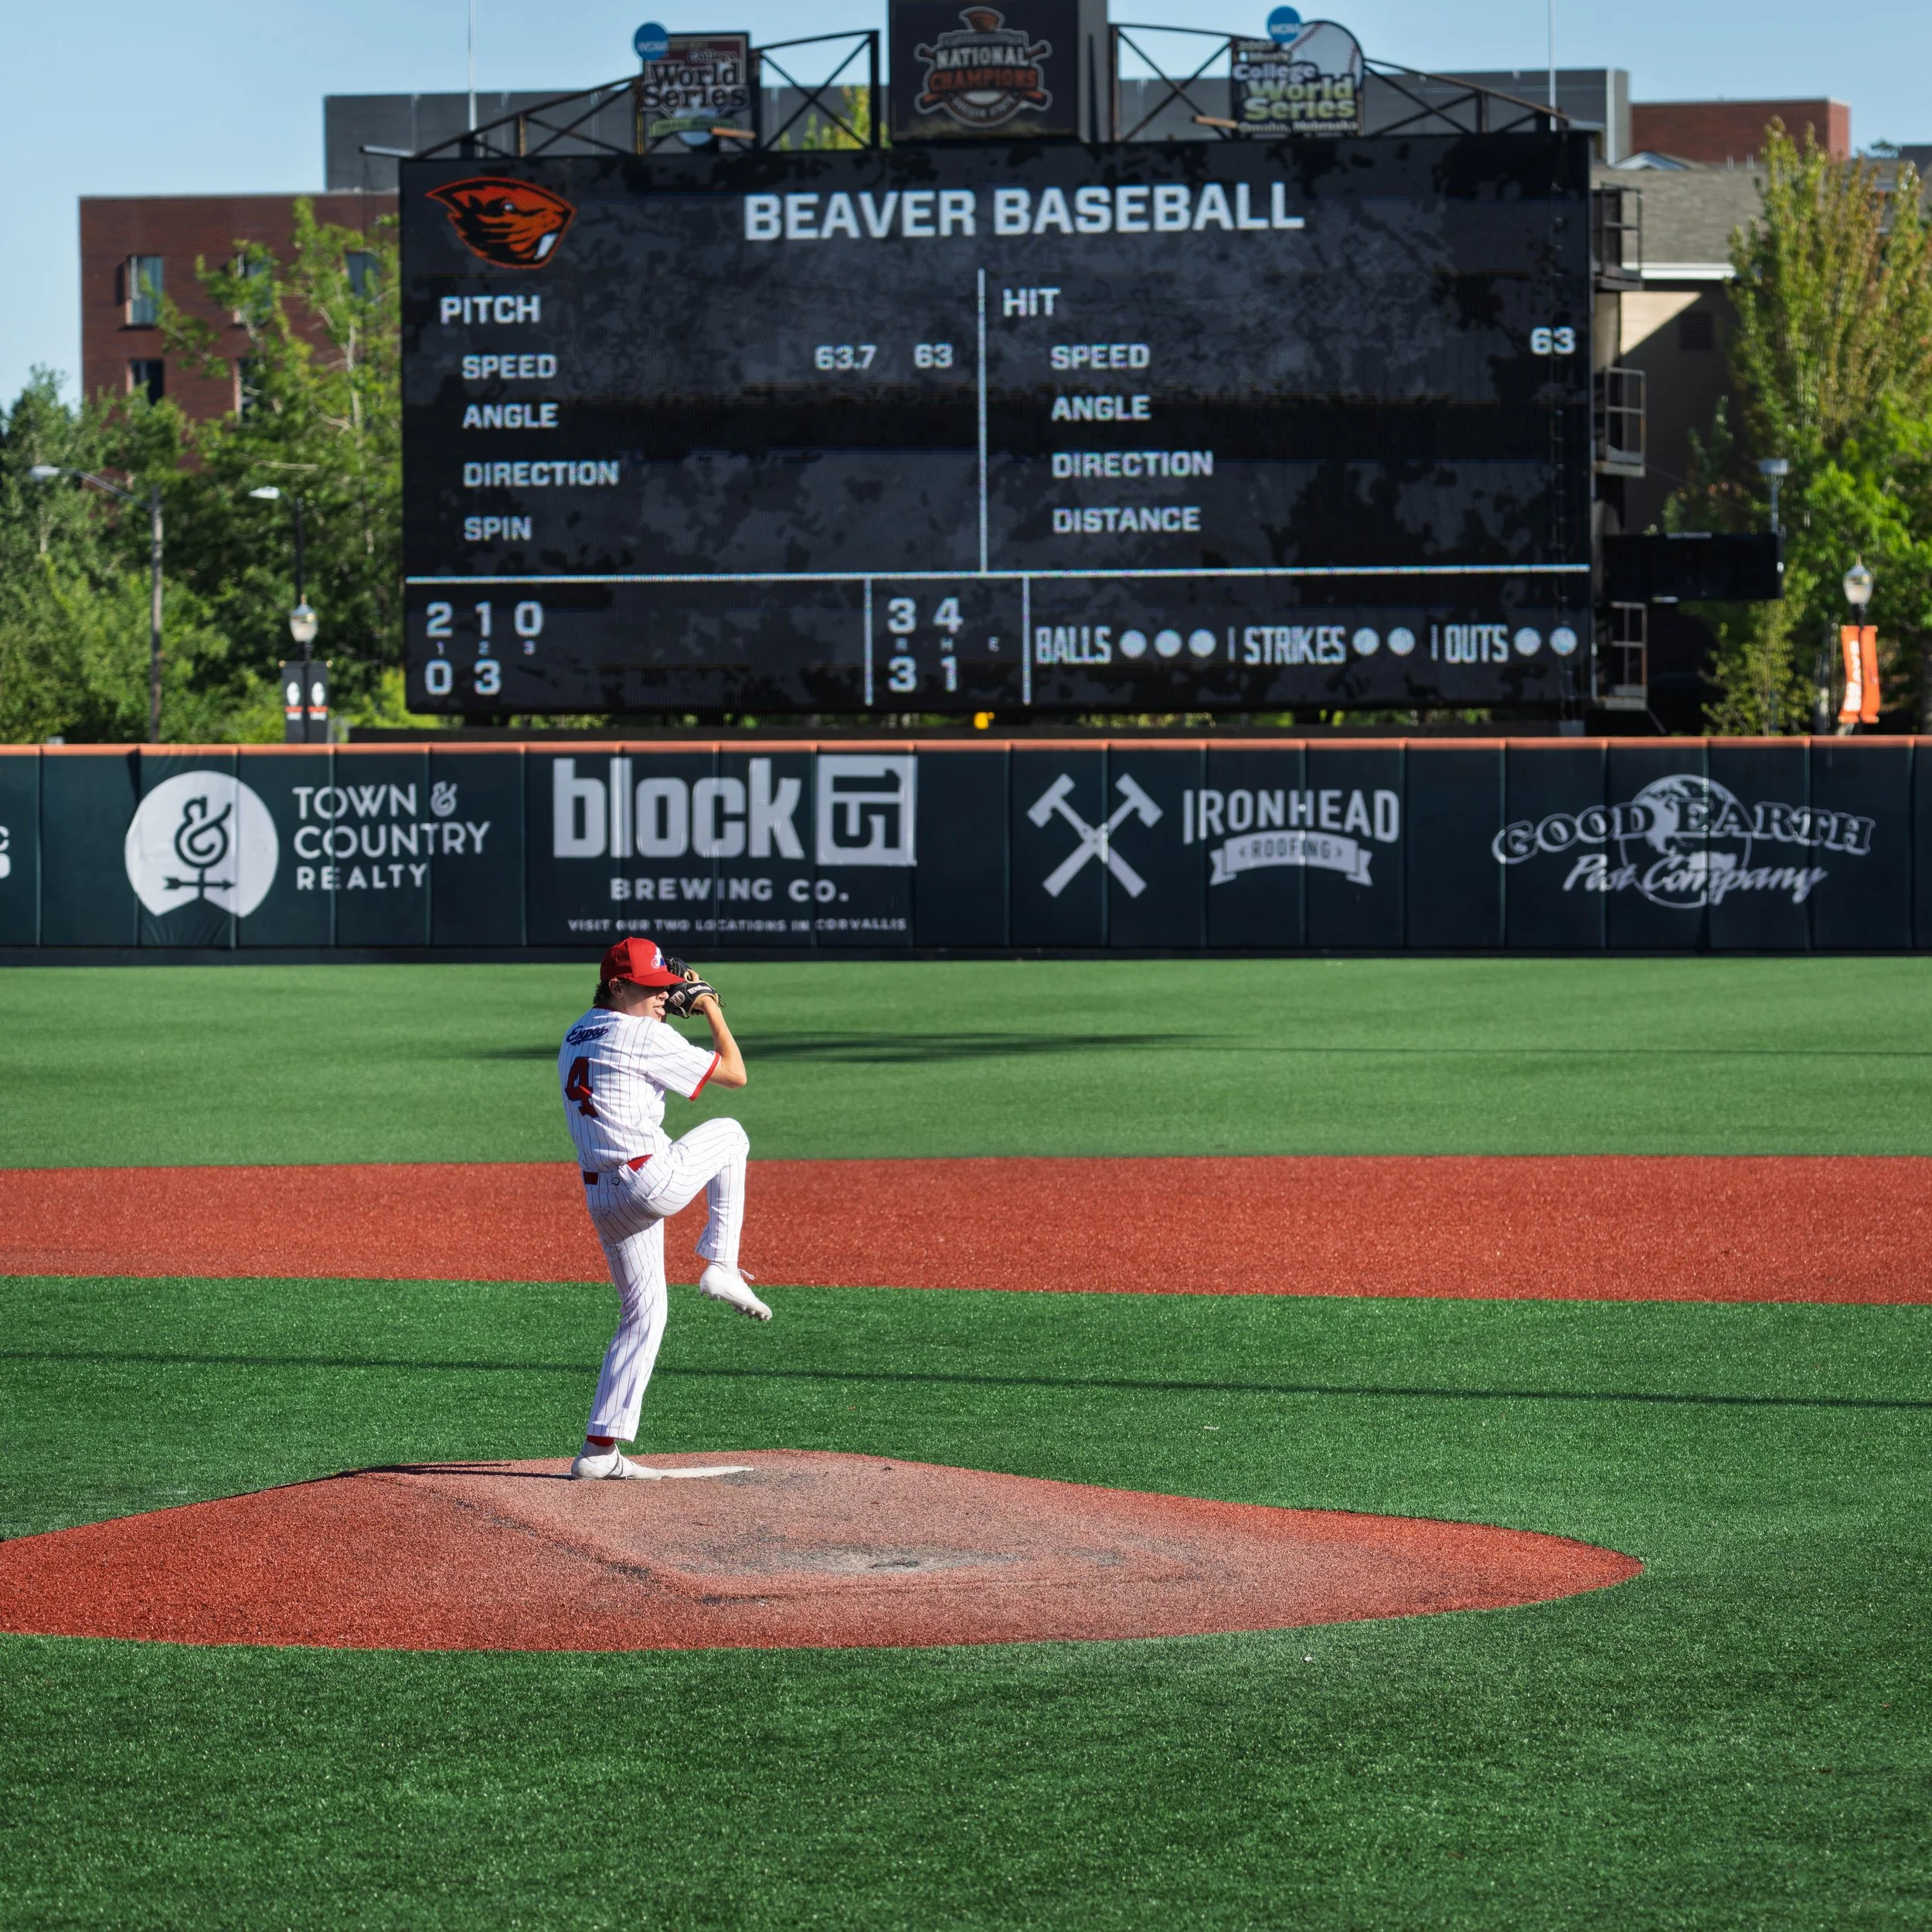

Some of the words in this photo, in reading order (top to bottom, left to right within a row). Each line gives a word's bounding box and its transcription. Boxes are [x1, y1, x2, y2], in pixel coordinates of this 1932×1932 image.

[936, 46, 1030, 69] NATIONAL
[648, 63, 740, 86] World
[930, 67, 1039, 91] CHAMPIONS
[1233, 63, 1317, 84] College
[1247, 76, 1353, 100] World
[643, 85, 749, 108] Series
[1243, 96, 1357, 121] Series
[744, 190, 976, 241] BEAVER
[993, 182, 1305, 236] BASEBALL
[440, 294, 542, 325] PITCH
[1002, 287, 1062, 318] HIT
[461, 352, 559, 380] SPEED
[814, 343, 878, 371] 63.7
[913, 342, 954, 369] 63
[1050, 342, 1151, 371] SPEED
[1529, 325, 1577, 355] 63
[461, 402, 560, 430] ANGLE
[1050, 393, 1151, 422] ANGLE
[463, 460, 621, 488] DIRECTION
[1051, 450, 1214, 478] DIRECTION
[463, 515, 533, 543] SPIN
[1052, 505, 1202, 534] DISTANCE
[426, 600, 453, 638] 2
[474, 600, 492, 638] 1
[514, 600, 544, 638] 0
[888, 597, 917, 634] 3
[932, 597, 964, 634] 4
[523, 640, 536, 656] 3
[1036, 625, 1113, 665] BALLS
[1243, 624, 1347, 665] STRIKES
[1444, 624, 1509, 665] OUTS
[425, 658, 453, 695] 0
[473, 658, 502, 695] 3
[888, 655, 917, 693] 3
[940, 655, 957, 693] 1
[292, 783, 417, 821] TOWN
[429, 780, 458, 817] &
[553, 757, 805, 860] block
[1182, 789, 1400, 845] IRONHEAD
[1492, 801, 1655, 865] GOOD
[1670, 796, 1876, 855] EARTH
[293, 820, 491, 860] COUNTRY
[1250, 838, 1332, 860] ROOFING
[295, 862, 427, 892] REALTY
[610, 877, 773, 902] BREWING
[788, 878, 849, 903] CO.
[1563, 853, 1637, 891] Pest
[1642, 853, 1828, 906] Company
[567, 917, 611, 932] VISIT
[615, 918, 651, 932] OUR
[653, 918, 691, 932] TWO
[695, 918, 787, 932] LOCATIONS
[791, 918, 811, 932] IN
[815, 917, 906, 931] CORVALLIS
[564, 1056, 600, 1119] 4
